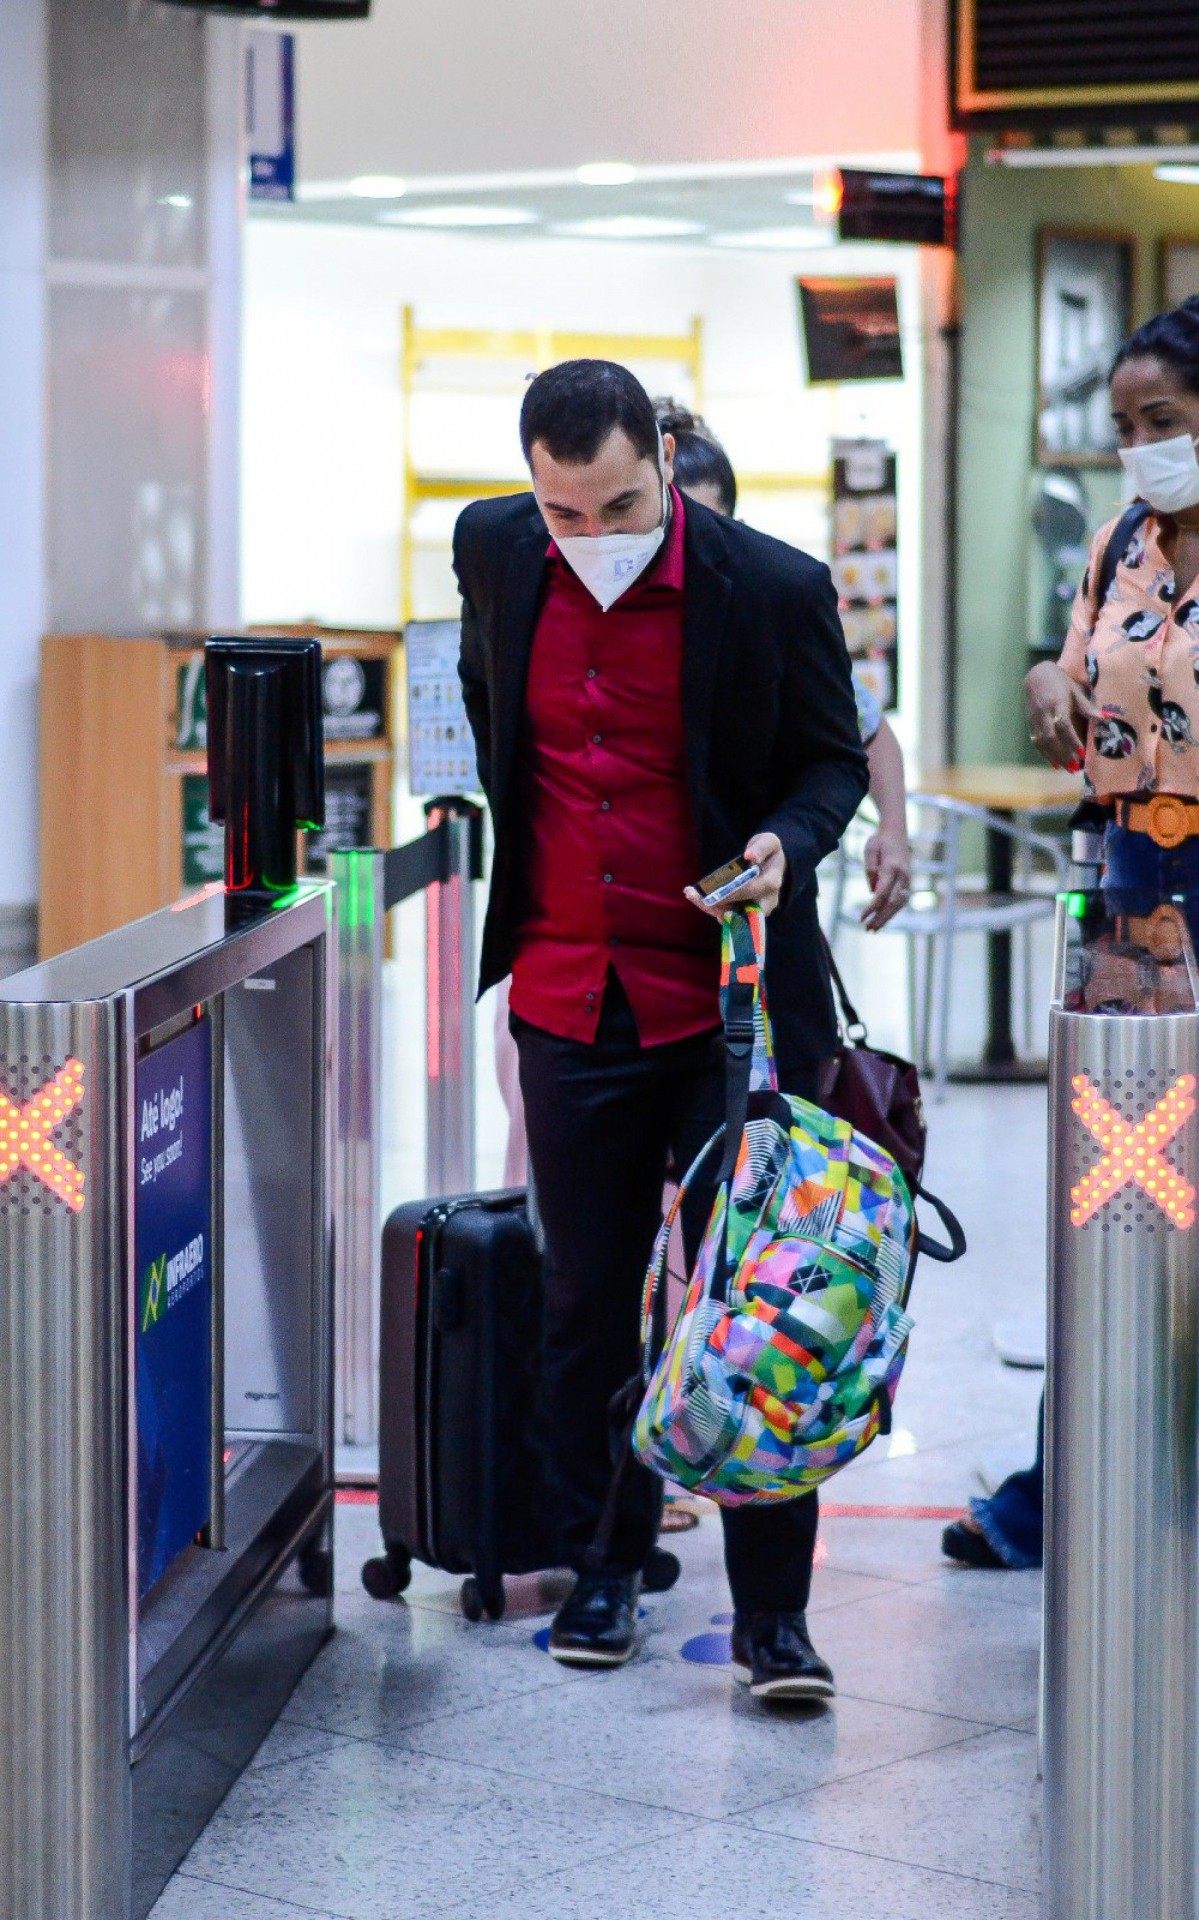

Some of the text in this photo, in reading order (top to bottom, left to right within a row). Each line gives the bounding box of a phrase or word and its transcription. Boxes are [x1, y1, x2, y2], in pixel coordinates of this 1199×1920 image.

[141, 1075, 183, 1141] Até logo!
[141, 1130, 183, 1184] See you soon!
[167, 1233, 204, 1292] INFRAERO
